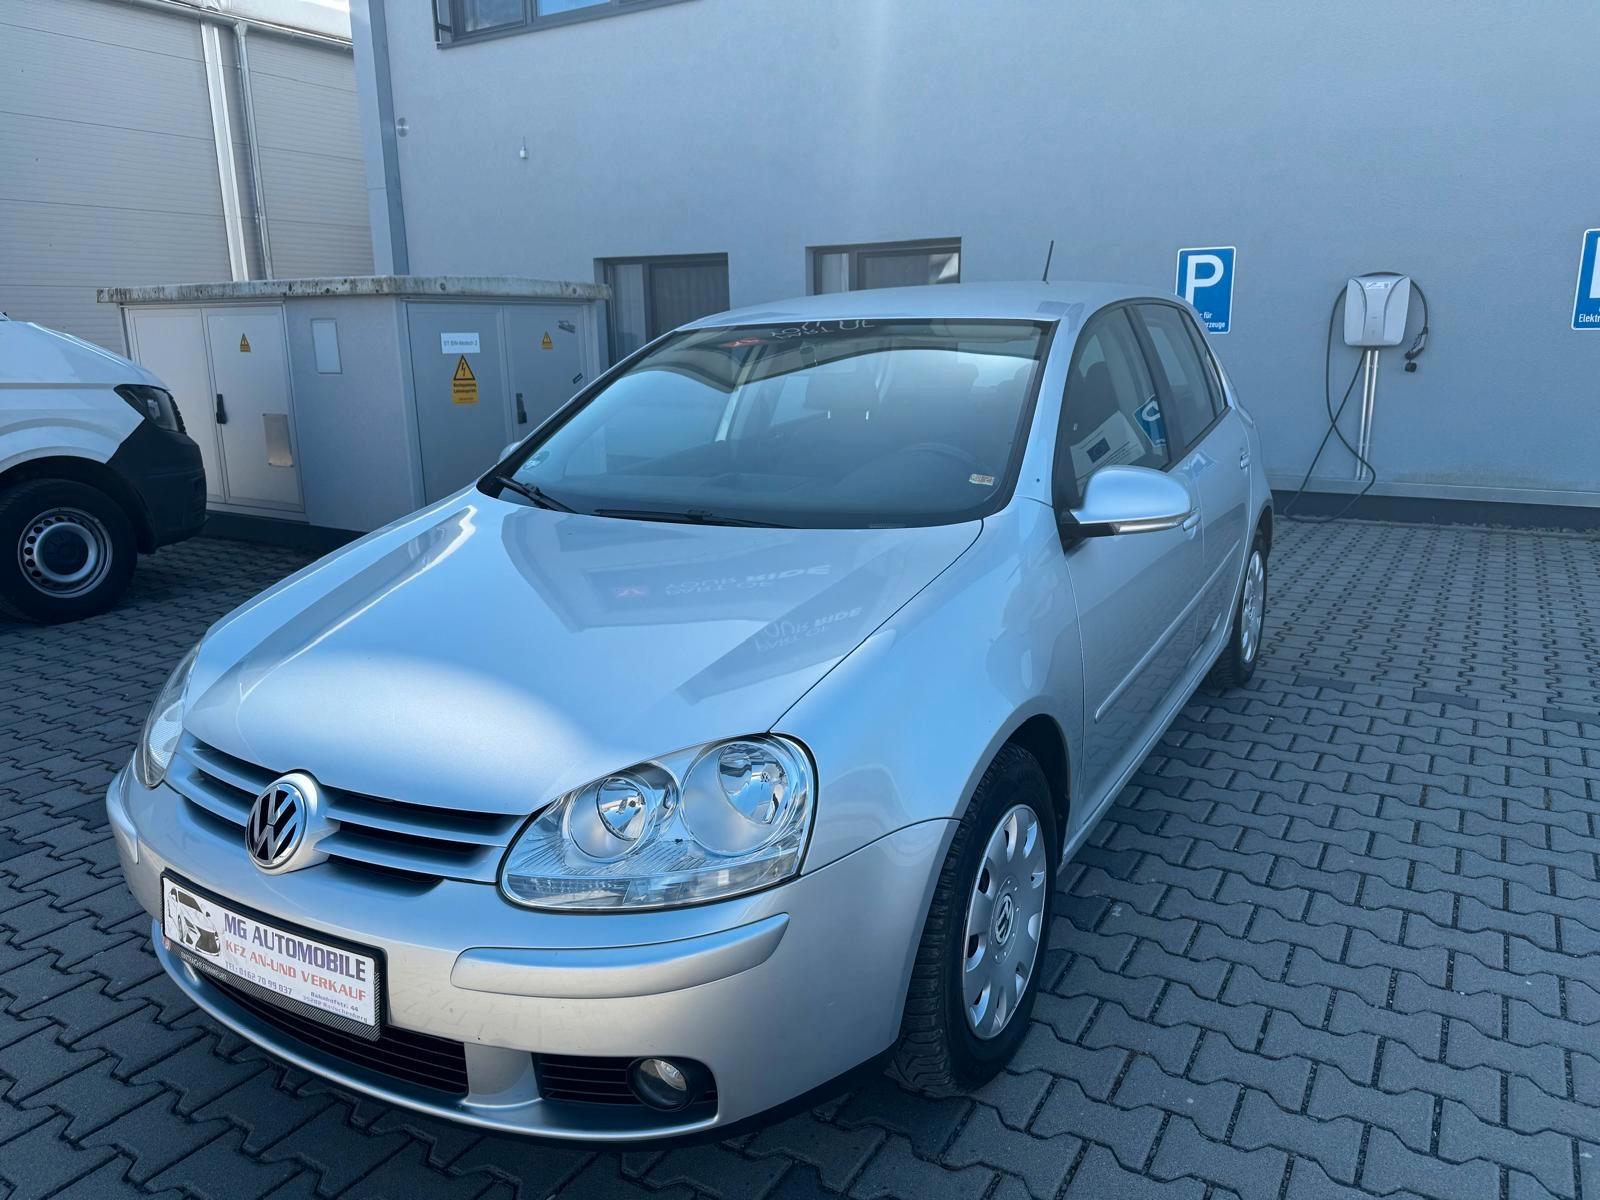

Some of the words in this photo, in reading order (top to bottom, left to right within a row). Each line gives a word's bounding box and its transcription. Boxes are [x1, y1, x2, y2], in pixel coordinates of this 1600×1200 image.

[1185, 254, 1224, 306] P
[224, 912, 247, 940] MG
[252, 925, 366, 982] AUTOMOBILE
[225, 940, 247, 958] KFZ
[250, 951, 297, 978] AN-UND
[301, 970, 366, 1001] VERKAUF
